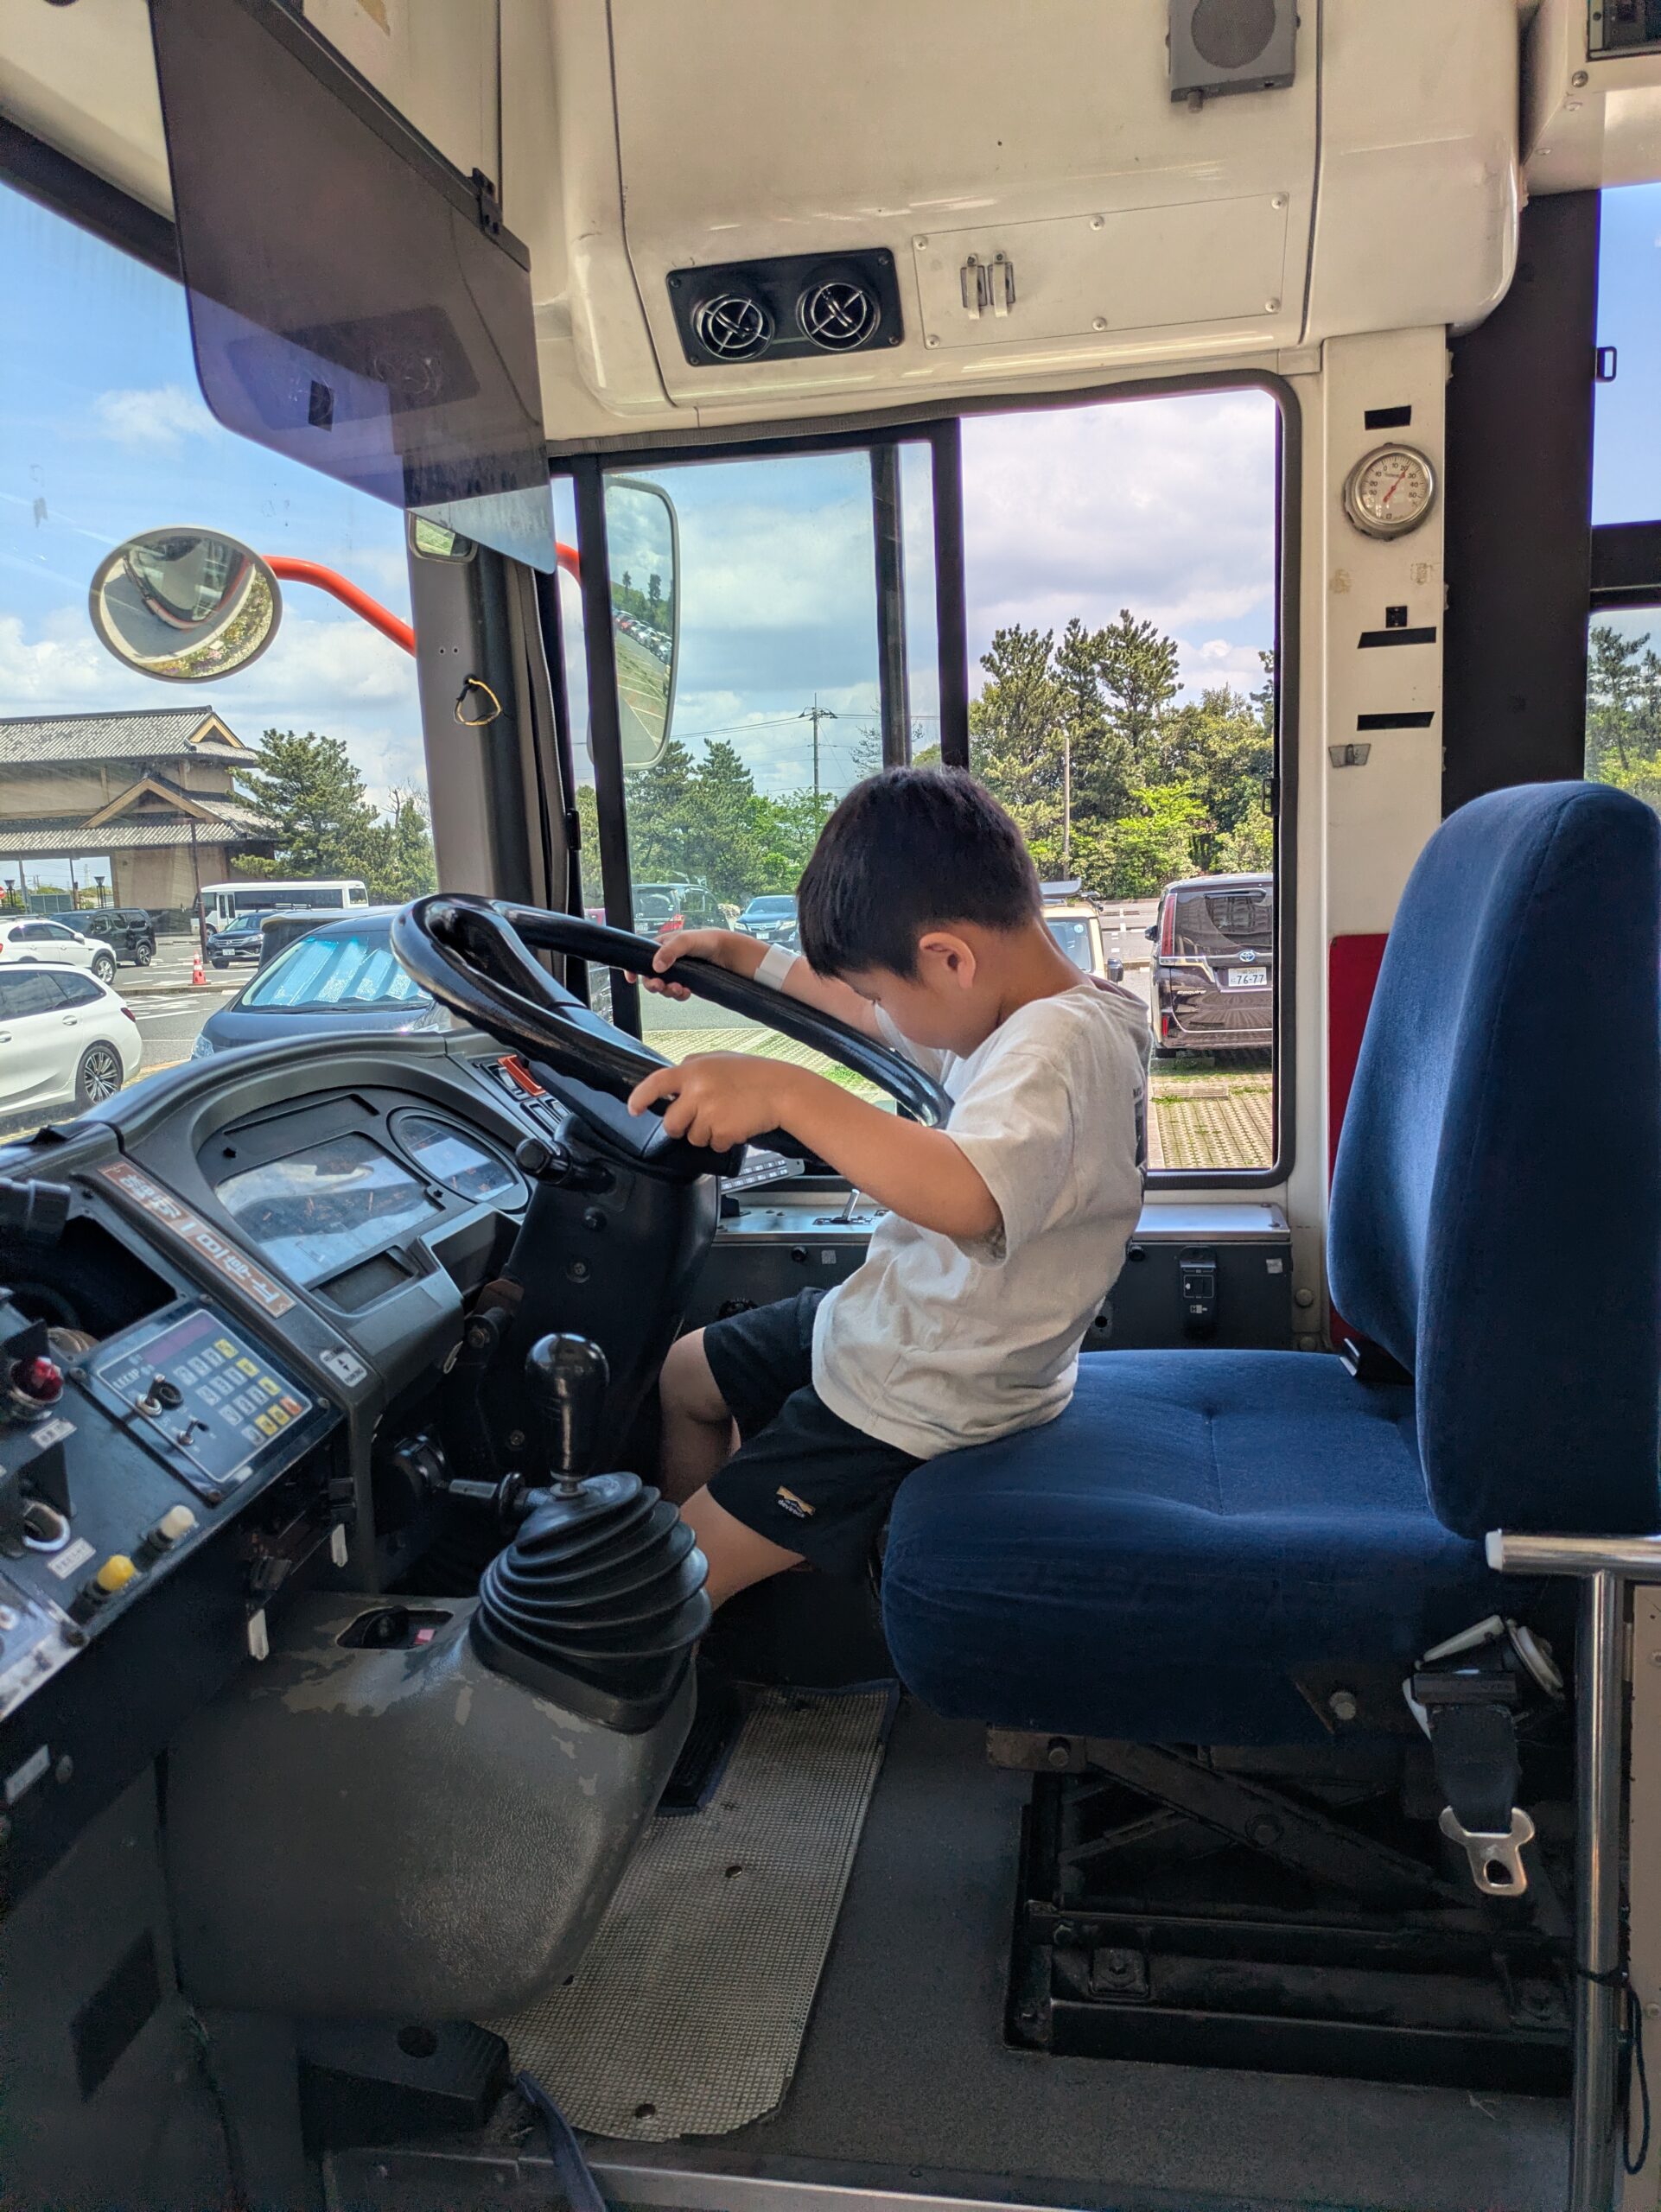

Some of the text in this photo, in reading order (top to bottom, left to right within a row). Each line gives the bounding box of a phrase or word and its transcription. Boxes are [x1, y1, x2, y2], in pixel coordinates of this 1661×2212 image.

[1237, 974, 1264, 985] 76-77
[118, 1174, 281, 1305] 踏切一旦停止
